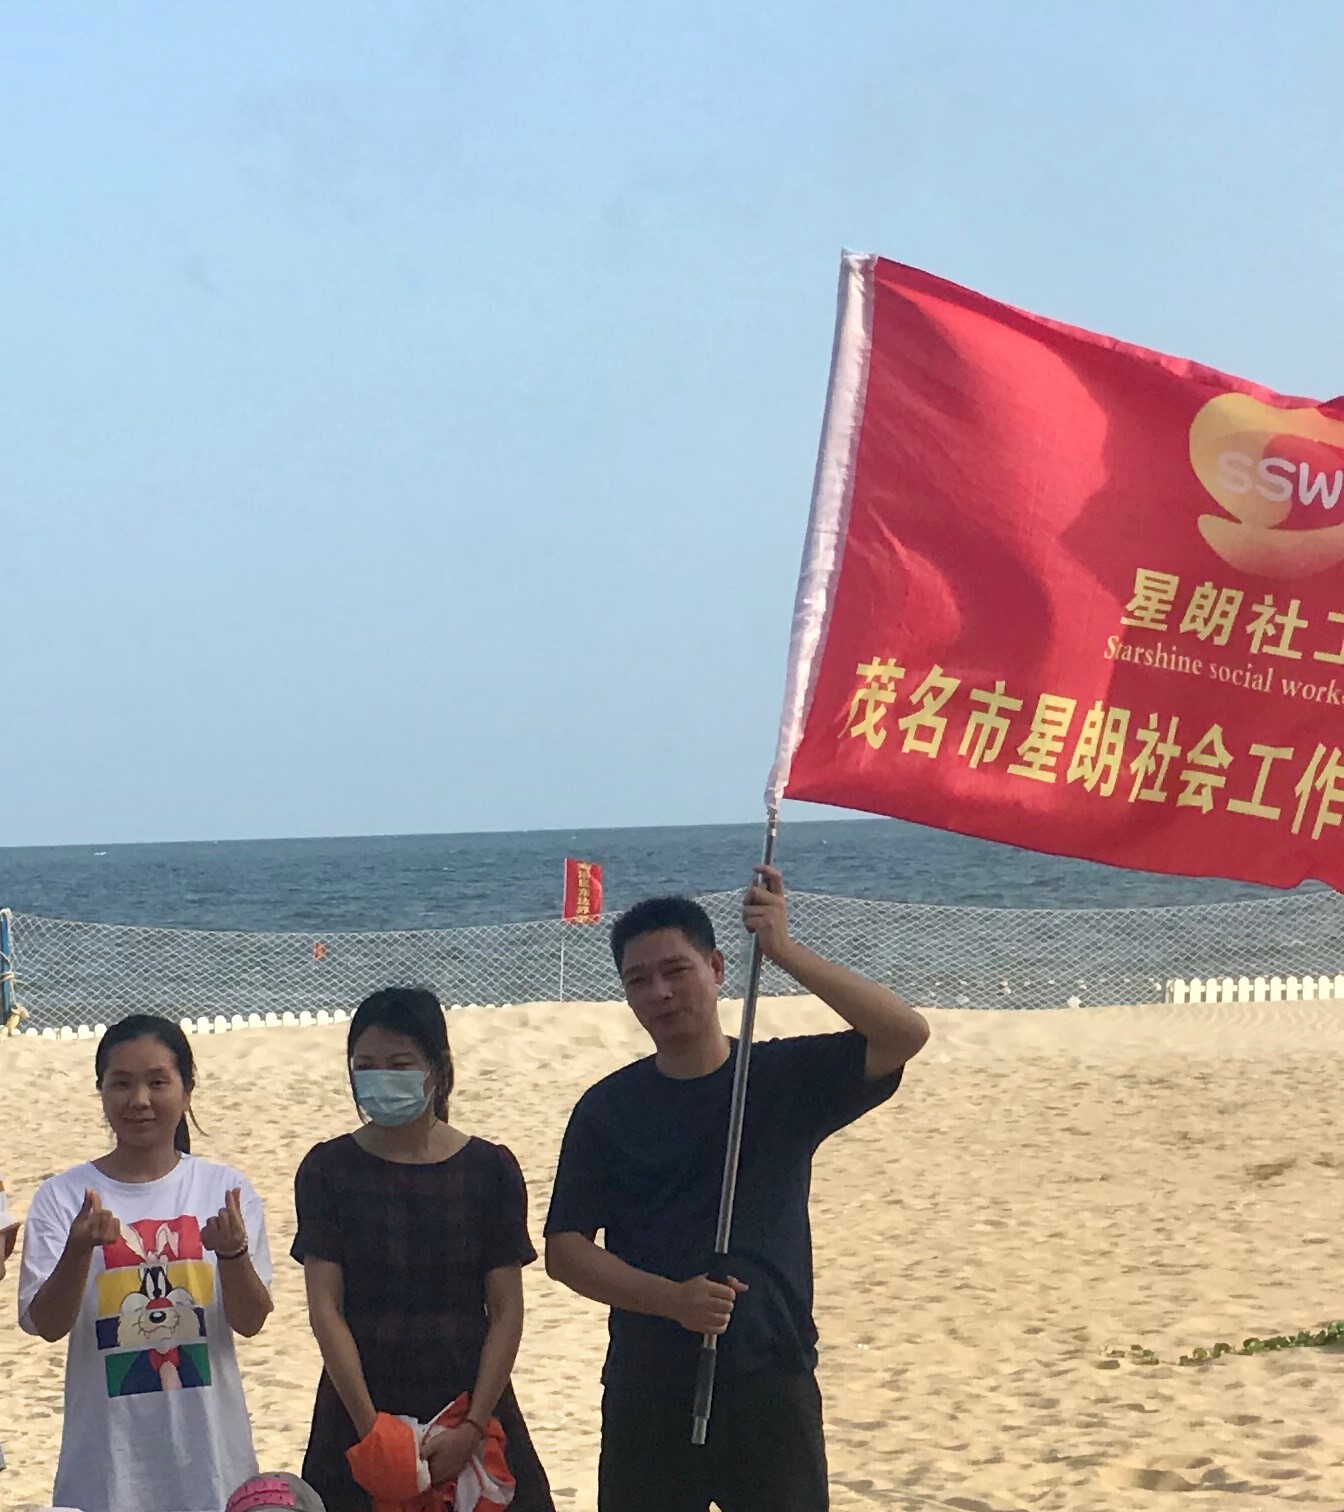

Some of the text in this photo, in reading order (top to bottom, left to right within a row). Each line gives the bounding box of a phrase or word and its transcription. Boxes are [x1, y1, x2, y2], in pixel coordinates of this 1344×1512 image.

[1216, 451, 1343, 509] SSW
[1104, 635, 1344, 705] Starshine social work
[837, 656, 1344, 841] 茂名市星朗社会工作
